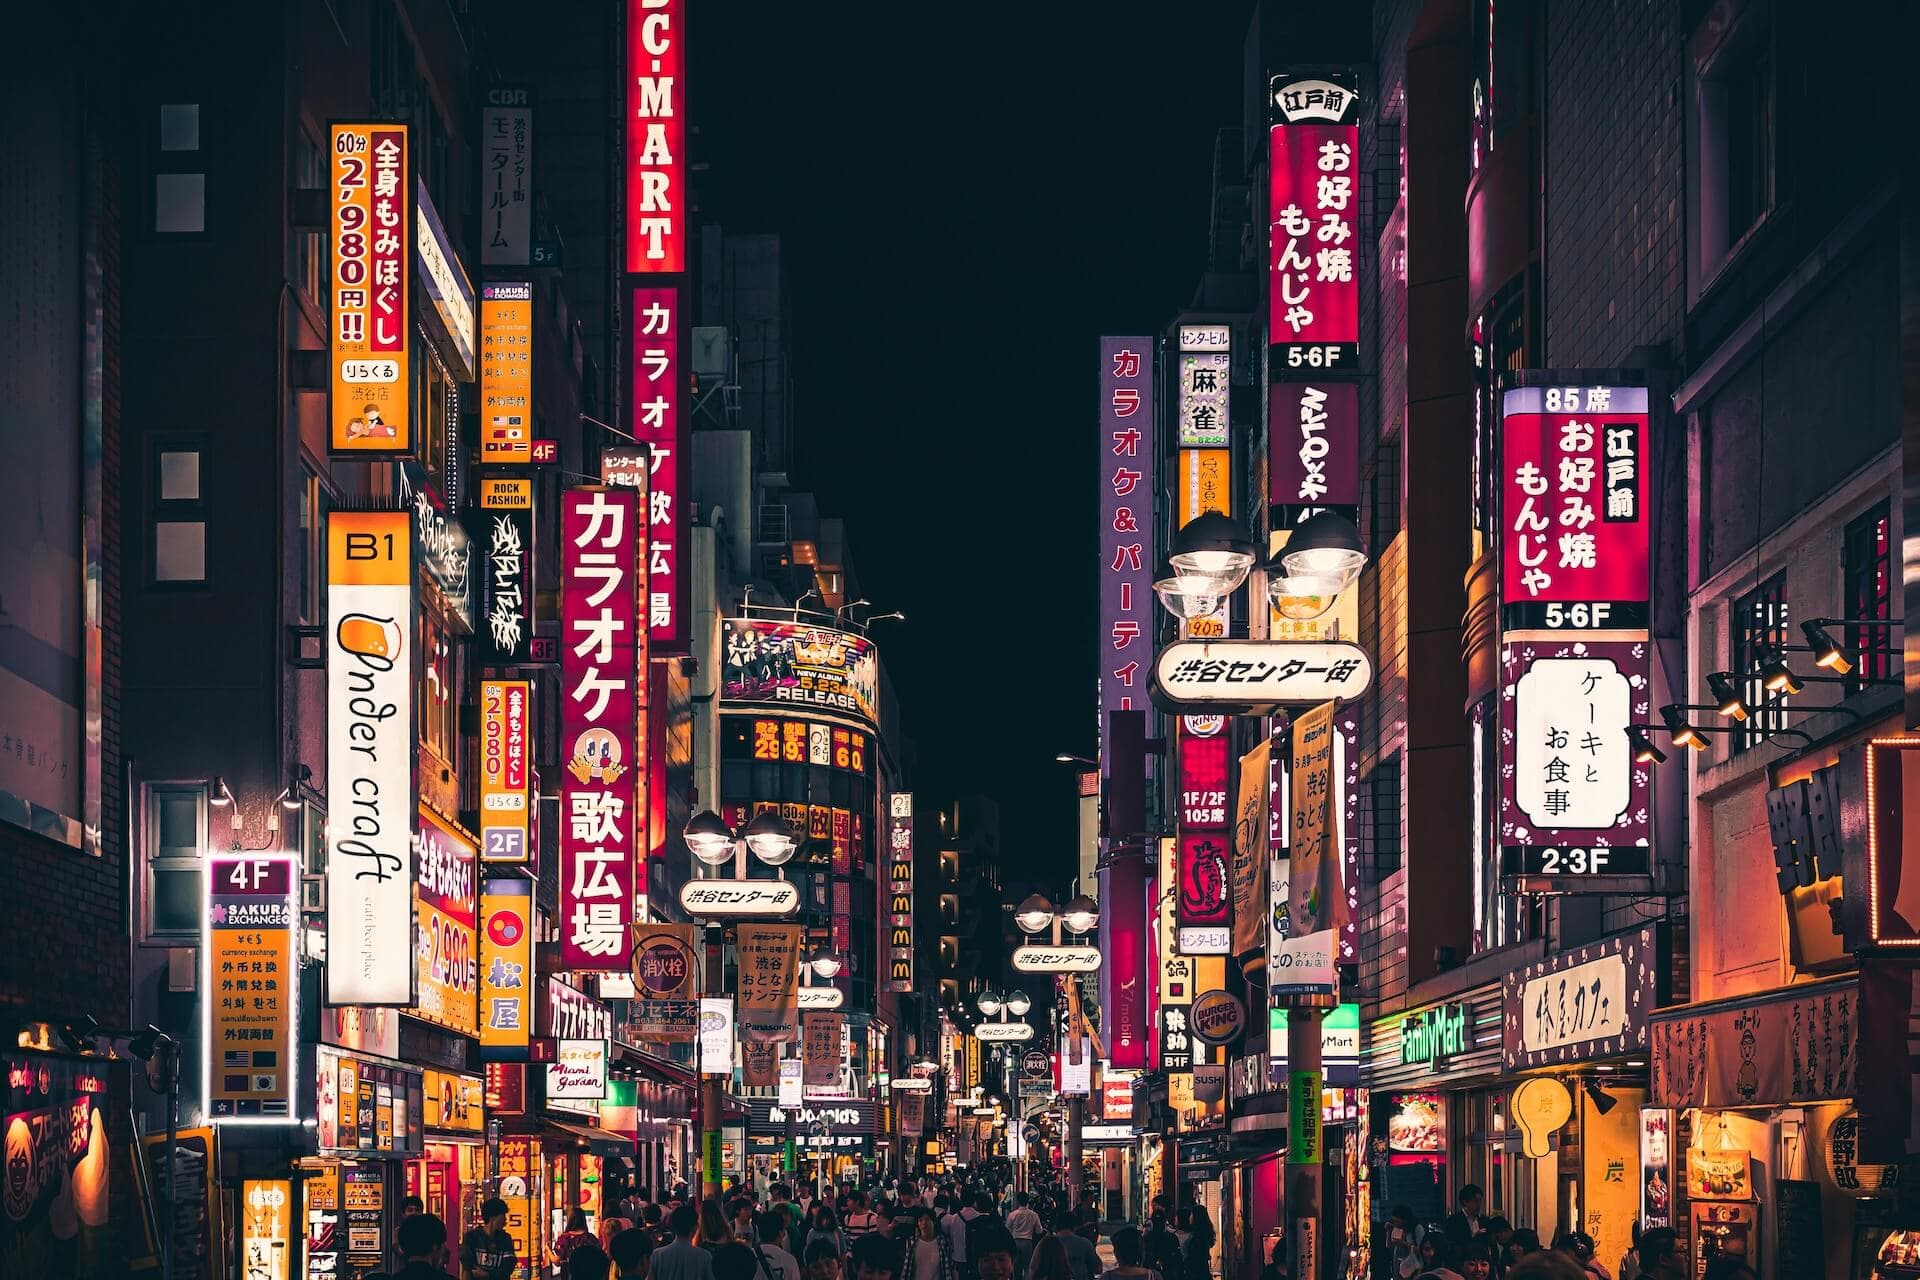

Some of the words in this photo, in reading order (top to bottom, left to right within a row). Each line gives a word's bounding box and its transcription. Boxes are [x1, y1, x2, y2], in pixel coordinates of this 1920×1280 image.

[1284, 89, 1344, 112] 江戸前
[638, 0, 674, 260] C-MART
[336, 132, 367, 154] 60分
[513, 117, 527, 203] 渋谷センター街
[490, 118, 510, 249] モニタールーム
[1316, 140, 1351, 282] お好み焼
[374, 138, 400, 346] 全身もみほぐし
[534, 247, 553, 262] 5F
[1278, 203, 1313, 333] もんじゃ
[1181, 332, 1228, 345] センタービル
[1214, 356, 1229, 365] 5F
[346, 365, 394, 378] りらくる
[351, 386, 389, 401] 渋谷店
[1191, 368, 1218, 430] 麻雀
[533, 444, 554, 460] 4F
[1606, 429, 1635, 519] 江戸前
[494, 483, 519, 493] ROCK
[1558, 419, 1596, 569] お好み焼
[487, 495, 526, 505] FASHION
[1514, 461, 1551, 598] もんじゃ
[346, 533, 393, 560] B1
[573, 493, 625, 722] カラオケ
[1280, 621, 1317, 634] 北海道
[796, 669, 816, 678] NEW
[817, 673, 843, 682] ALBUM
[1168, 659, 1361, 684] 渋谷センター街
[801, 677, 840, 694] 5.23
[776, 687, 857, 710] RELEASE
[1579, 669, 1604, 784] ケーキと
[509, 690, 521, 785] 全身もみほぐし
[1543, 724, 1571, 817] お食事
[1307, 768, 1328, 797] 渋谷
[488, 796, 521, 807] りらくる
[1183, 791, 1226, 806] 1F/2F
[1184, 809, 1225, 823] 105席
[336, 777, 402, 884] craft
[490, 833, 520, 853] 2F
[229, 860, 271, 890] 4F
[418, 828, 475, 913] 全身もみほぐし
[570, 791, 625, 957] 歌広場
[686, 890, 792, 904] 渋谷センター街
[228, 904, 290, 916] SAKURA
[1181, 933, 1229, 947] センタービル
[221, 961, 278, 974] 外币兑换
[643, 958, 684, 977] 消火栓
[755, 956, 783, 970] 渋谷
[1019, 953, 1098, 965] 渋谷センター街
[1272, 954, 1292, 968] この
[742, 974, 794, 986] おとなり
[487, 958, 523, 1030] 松屋
[742, 989, 795, 1001] サンデー
[221, 998, 246, 1010] 외화
[1199, 1002, 1236, 1020] BURGER
[1535, 977, 1609, 1043] 椿屋カフェ
[746, 1022, 792, 1032] Panasonic
[1200, 1012, 1237, 1032] KING
[224, 1028, 275, 1041] 外貨両替
[1400, 1003, 1465, 1072] FamilyMart
[549, 1064, 591, 1075] Miami
[1164, 1057, 1189, 1067] B1F
[556, 1076, 603, 1092] Garden
